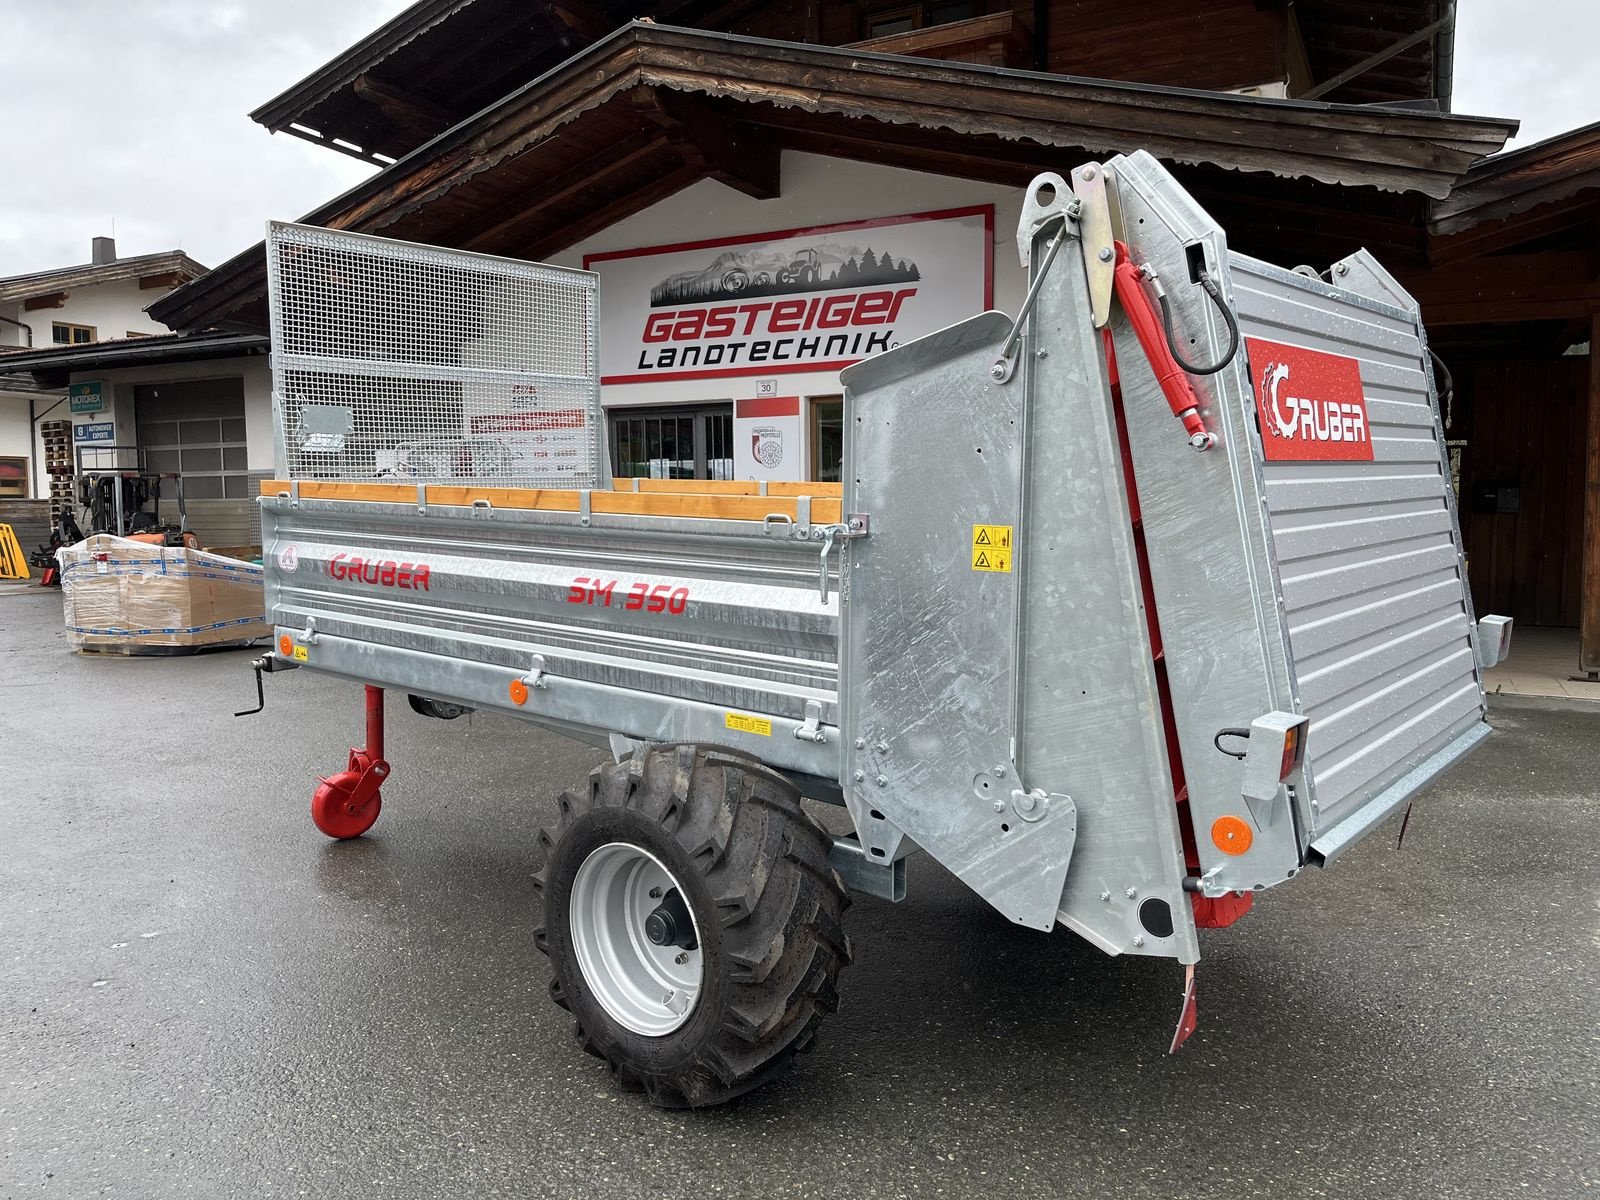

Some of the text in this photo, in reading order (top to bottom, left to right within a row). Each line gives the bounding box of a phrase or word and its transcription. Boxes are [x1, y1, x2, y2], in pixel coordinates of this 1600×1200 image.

[71, 394, 101, 405] MOTOREX
[761, 384, 771, 392] 30
[1263, 361, 1366, 442] GRUBER
[326, 552, 431, 592] GRUBER
[567, 577, 691, 615] SM 350
